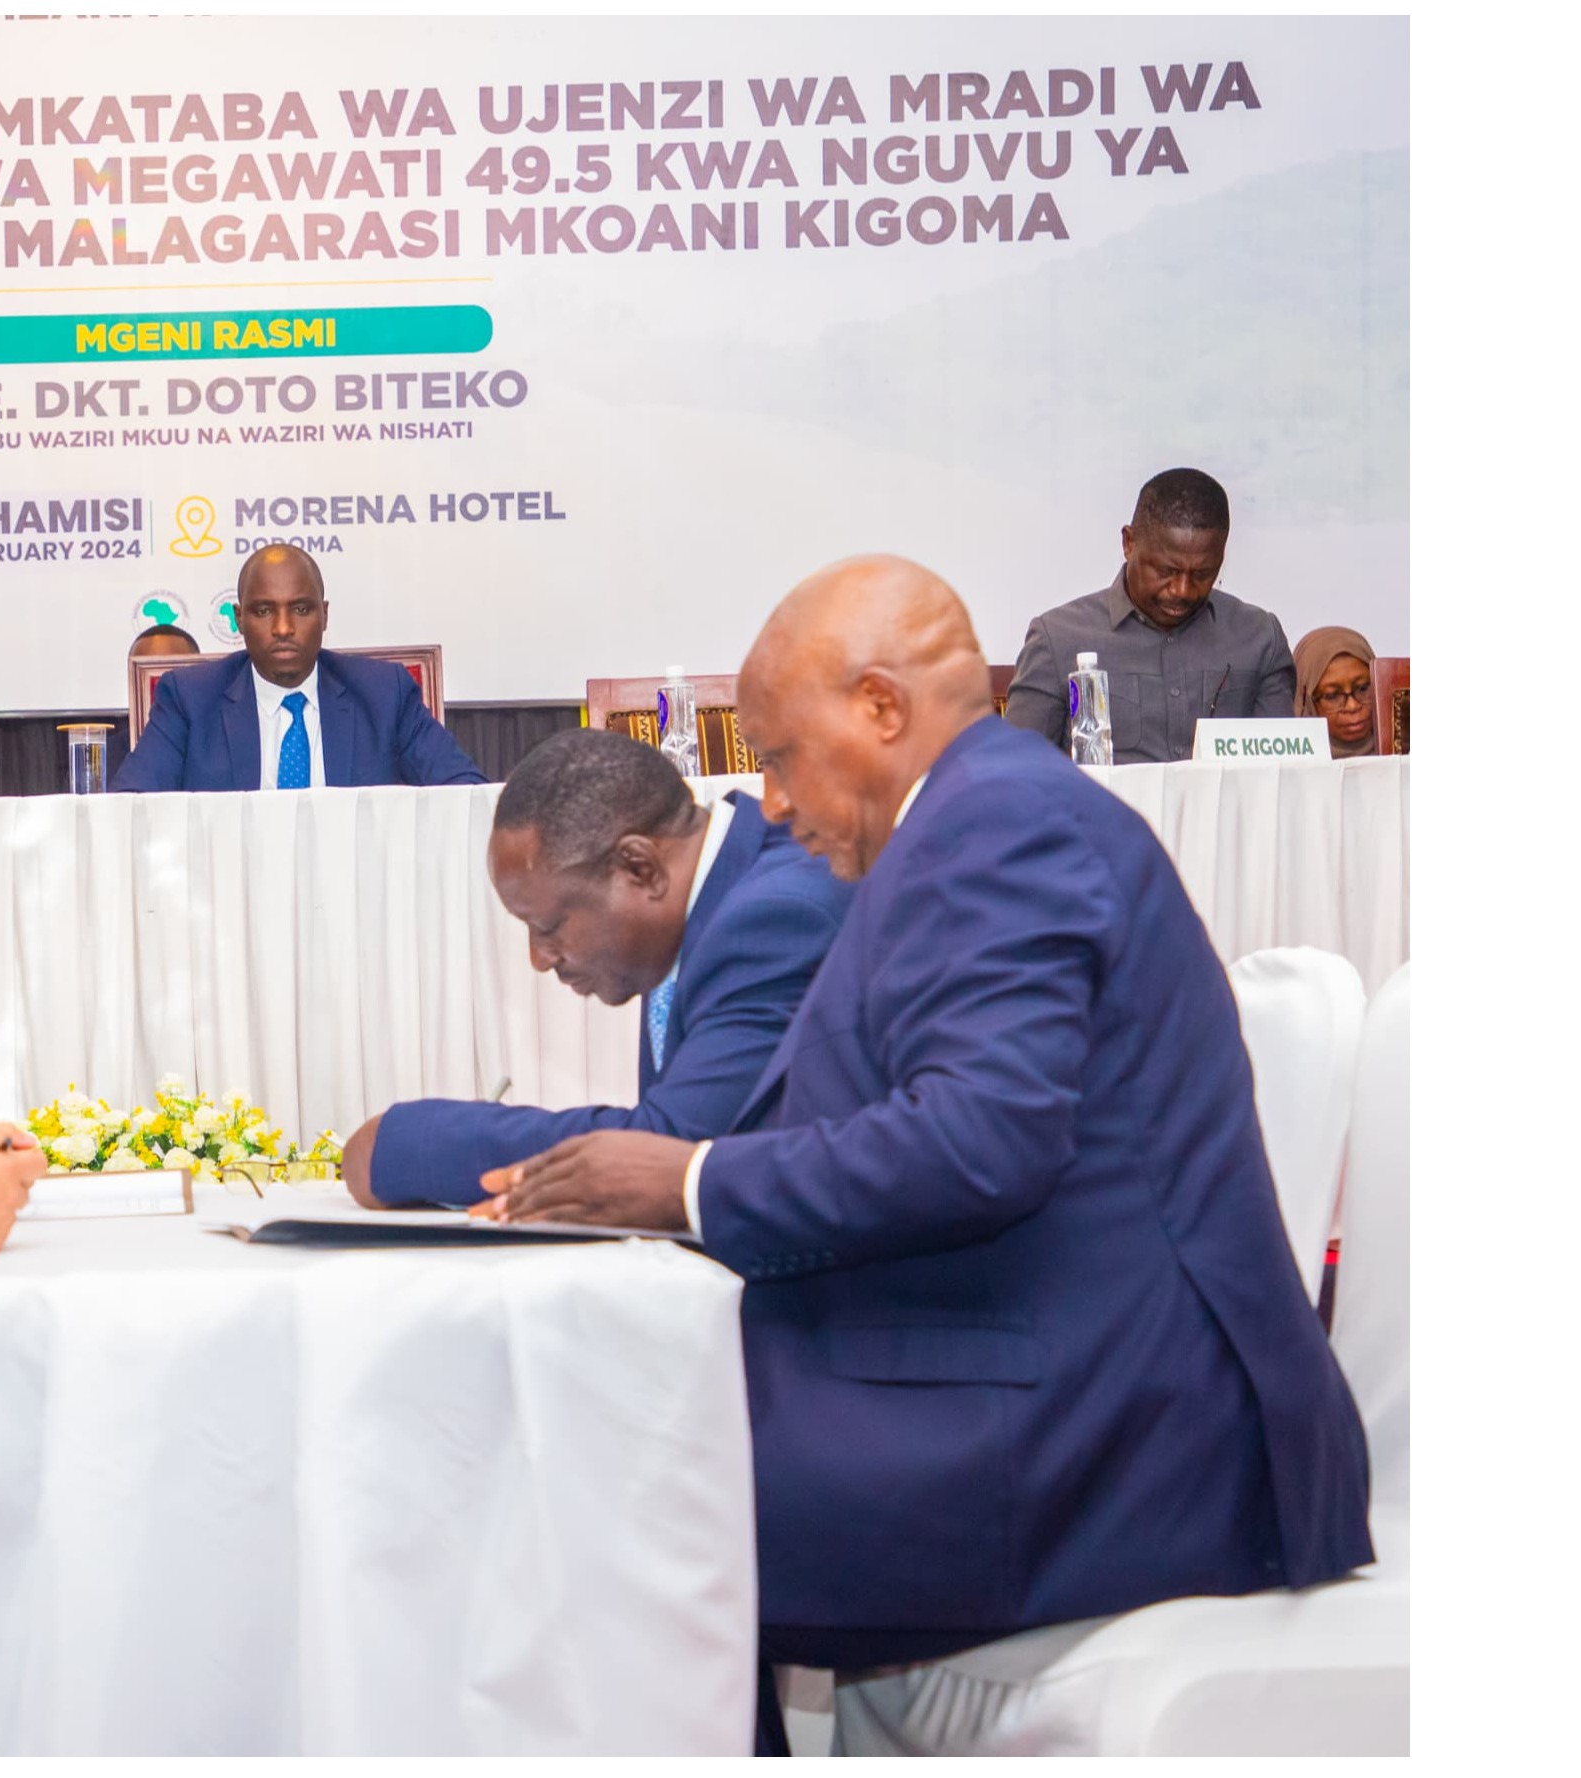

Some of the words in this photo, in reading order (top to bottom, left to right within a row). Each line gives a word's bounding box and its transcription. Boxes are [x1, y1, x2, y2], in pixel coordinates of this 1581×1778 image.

[339, 88, 456, 138] WA
[479, 80, 723, 134] UJENZI
[748, 76, 866, 126] WA
[890, 67, 1115, 122] MRADI
[1141, 61, 1261, 113] WA
[73, 149, 441, 205] MEGAWATI
[466, 144, 612, 195] 49.5
[637, 139, 799, 191] KWA
[823, 130, 1071, 186] NGUVU
[1095, 126, 1189, 176] YA
[4, 210, 459, 268] MALAGARASI
[486, 202, 759, 255] MKOANI
[786, 192, 1070, 248] KIGOMA
[76, 321, 201, 353] MGENI
[214, 318, 335, 349] RASMI
[36, 380, 148, 418] DKT.
[168, 375, 316, 415] DOTO
[335, 370, 528, 411] BITEKO
[29, 430, 114, 448] WAZIRI
[123, 429, 189, 446] MKUU
[198, 428, 231, 444] NA
[240, 425, 324, 443] WAZIRI
[333, 424, 371, 441] WA
[380, 422, 472, 439] NISHATI
[236, 495, 416, 527] MORENA
[430, 491, 566, 522] HOTEL
[81, 540, 141, 559] 2024
[1215, 738, 1238, 756] RC
[1242, 737, 1314, 755] KIGOMA
